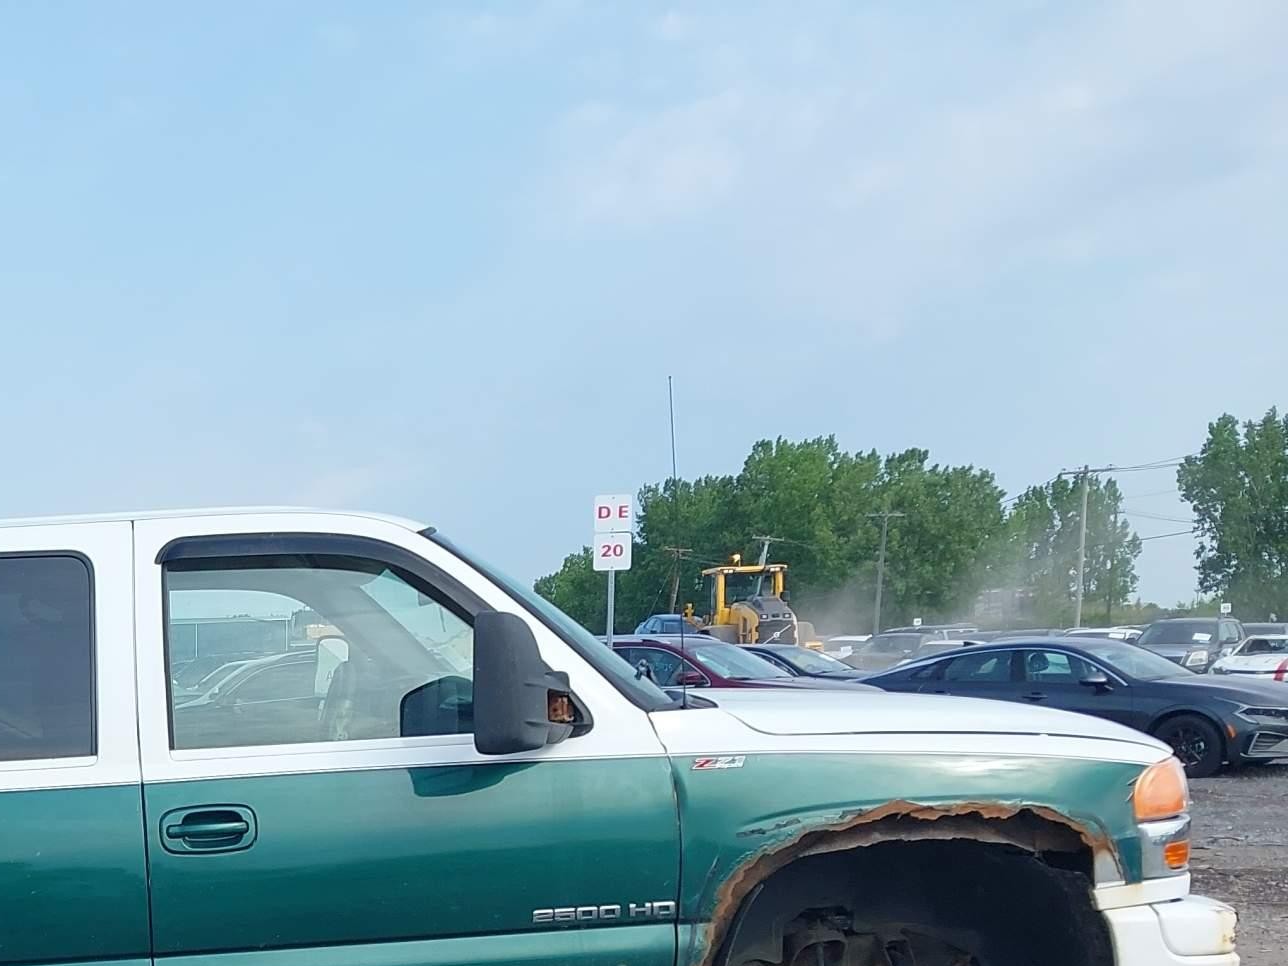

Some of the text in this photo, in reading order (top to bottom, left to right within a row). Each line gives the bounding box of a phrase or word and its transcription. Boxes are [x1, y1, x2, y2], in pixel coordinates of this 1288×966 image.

[598, 505, 629, 519] D E
[601, 544, 624, 558] 20
[533, 901, 676, 923] 2500 HD
